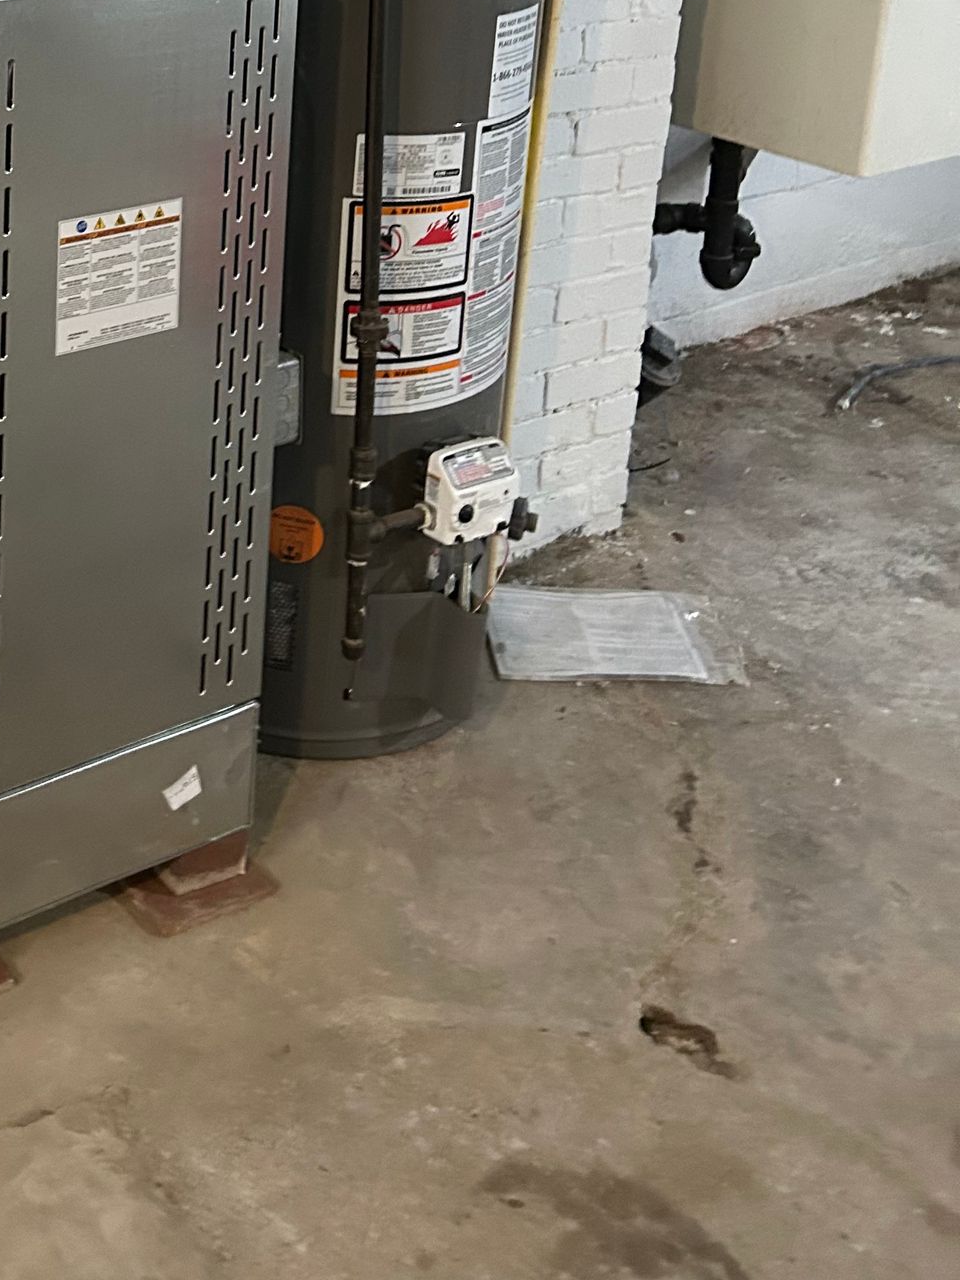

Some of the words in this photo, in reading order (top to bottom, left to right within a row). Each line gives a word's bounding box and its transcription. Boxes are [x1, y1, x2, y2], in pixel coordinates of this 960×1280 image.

[401, 205, 443, 215] WARNING
[397, 303, 433, 314] DANGER
[393, 366, 429, 378] WARNING
